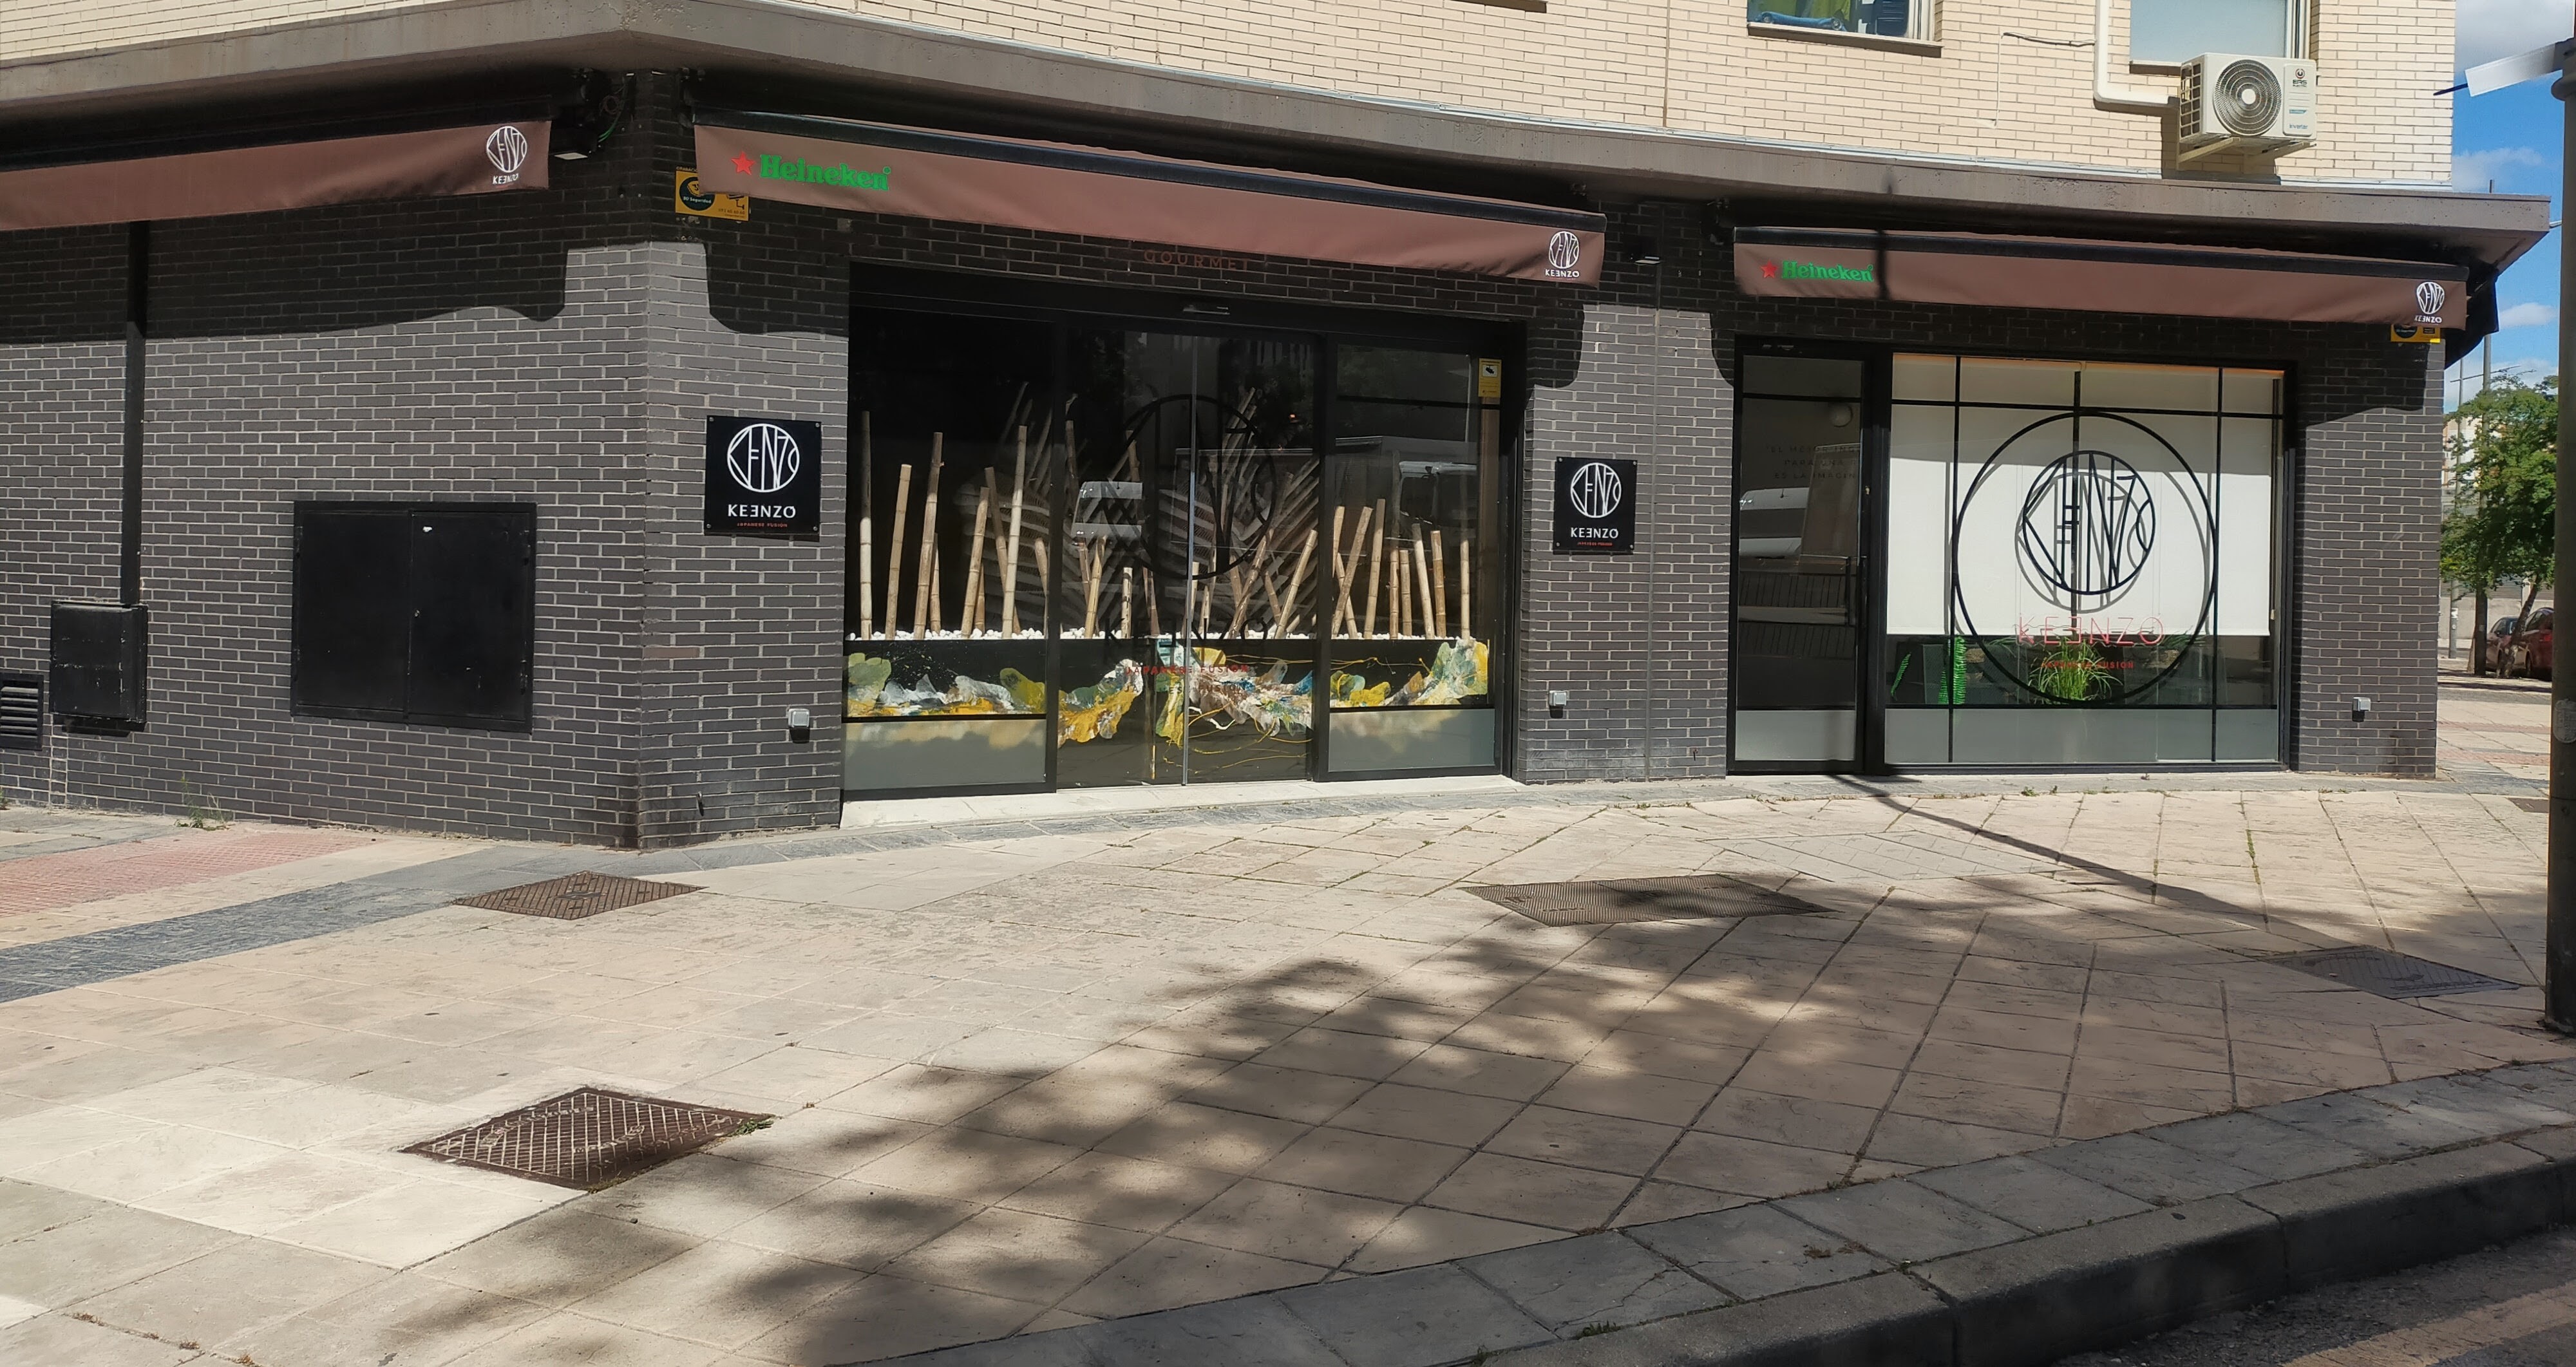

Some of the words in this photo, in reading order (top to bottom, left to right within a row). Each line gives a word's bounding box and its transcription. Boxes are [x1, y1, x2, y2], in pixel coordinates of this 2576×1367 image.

[760, 154, 889, 191] Heineken
[1144, 249, 1249, 271] GOURMET
[1781, 260, 1874, 283] Heineken
[1200, 665, 1248, 673] FUSION
